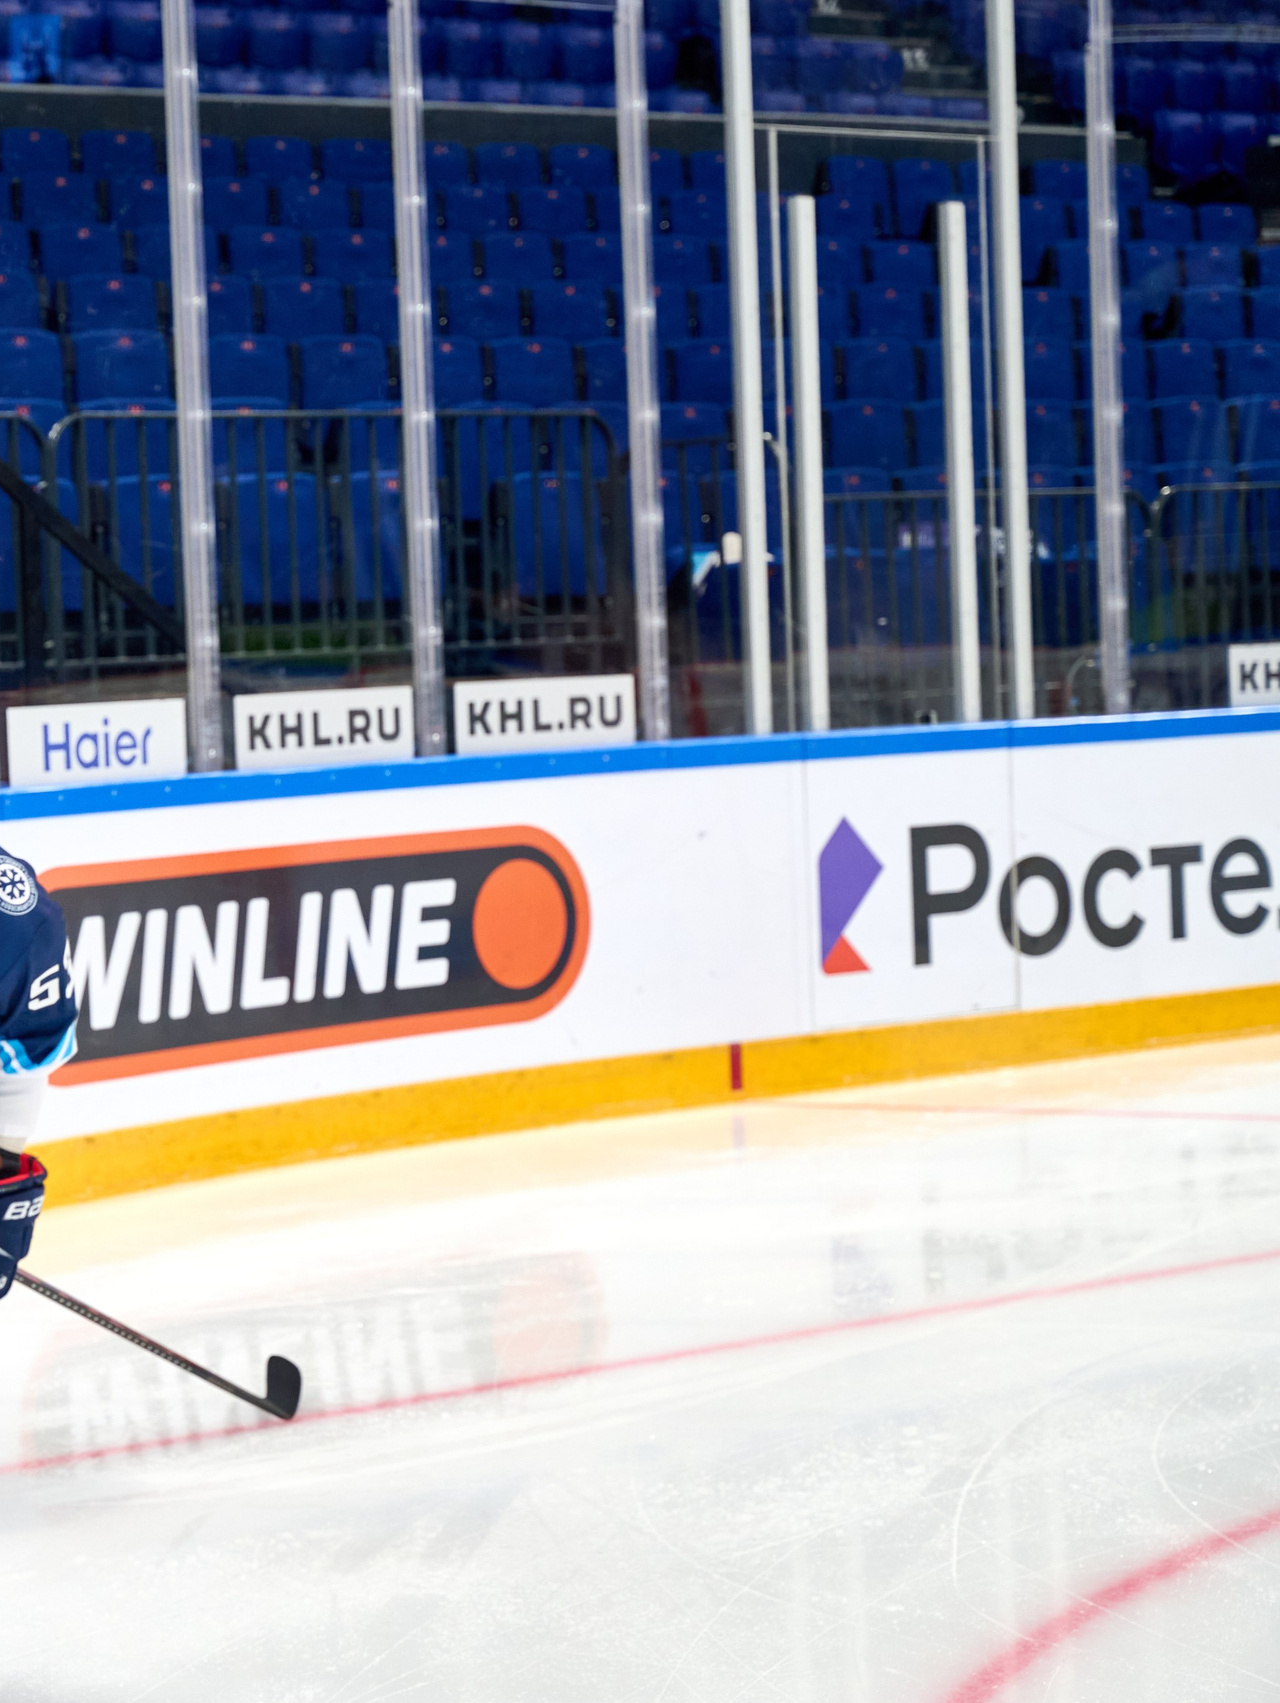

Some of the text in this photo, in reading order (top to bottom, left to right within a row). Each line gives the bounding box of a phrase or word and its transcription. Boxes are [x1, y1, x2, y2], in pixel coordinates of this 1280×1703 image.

[1239, 661, 1280, 692] KH
[247, 706, 402, 753] KHL.RU
[467, 694, 622, 738] KHL.RU
[41, 716, 153, 773] Haier
[908, 822, 1280, 968] Росте
[70, 877, 458, 1032] WINLINE
